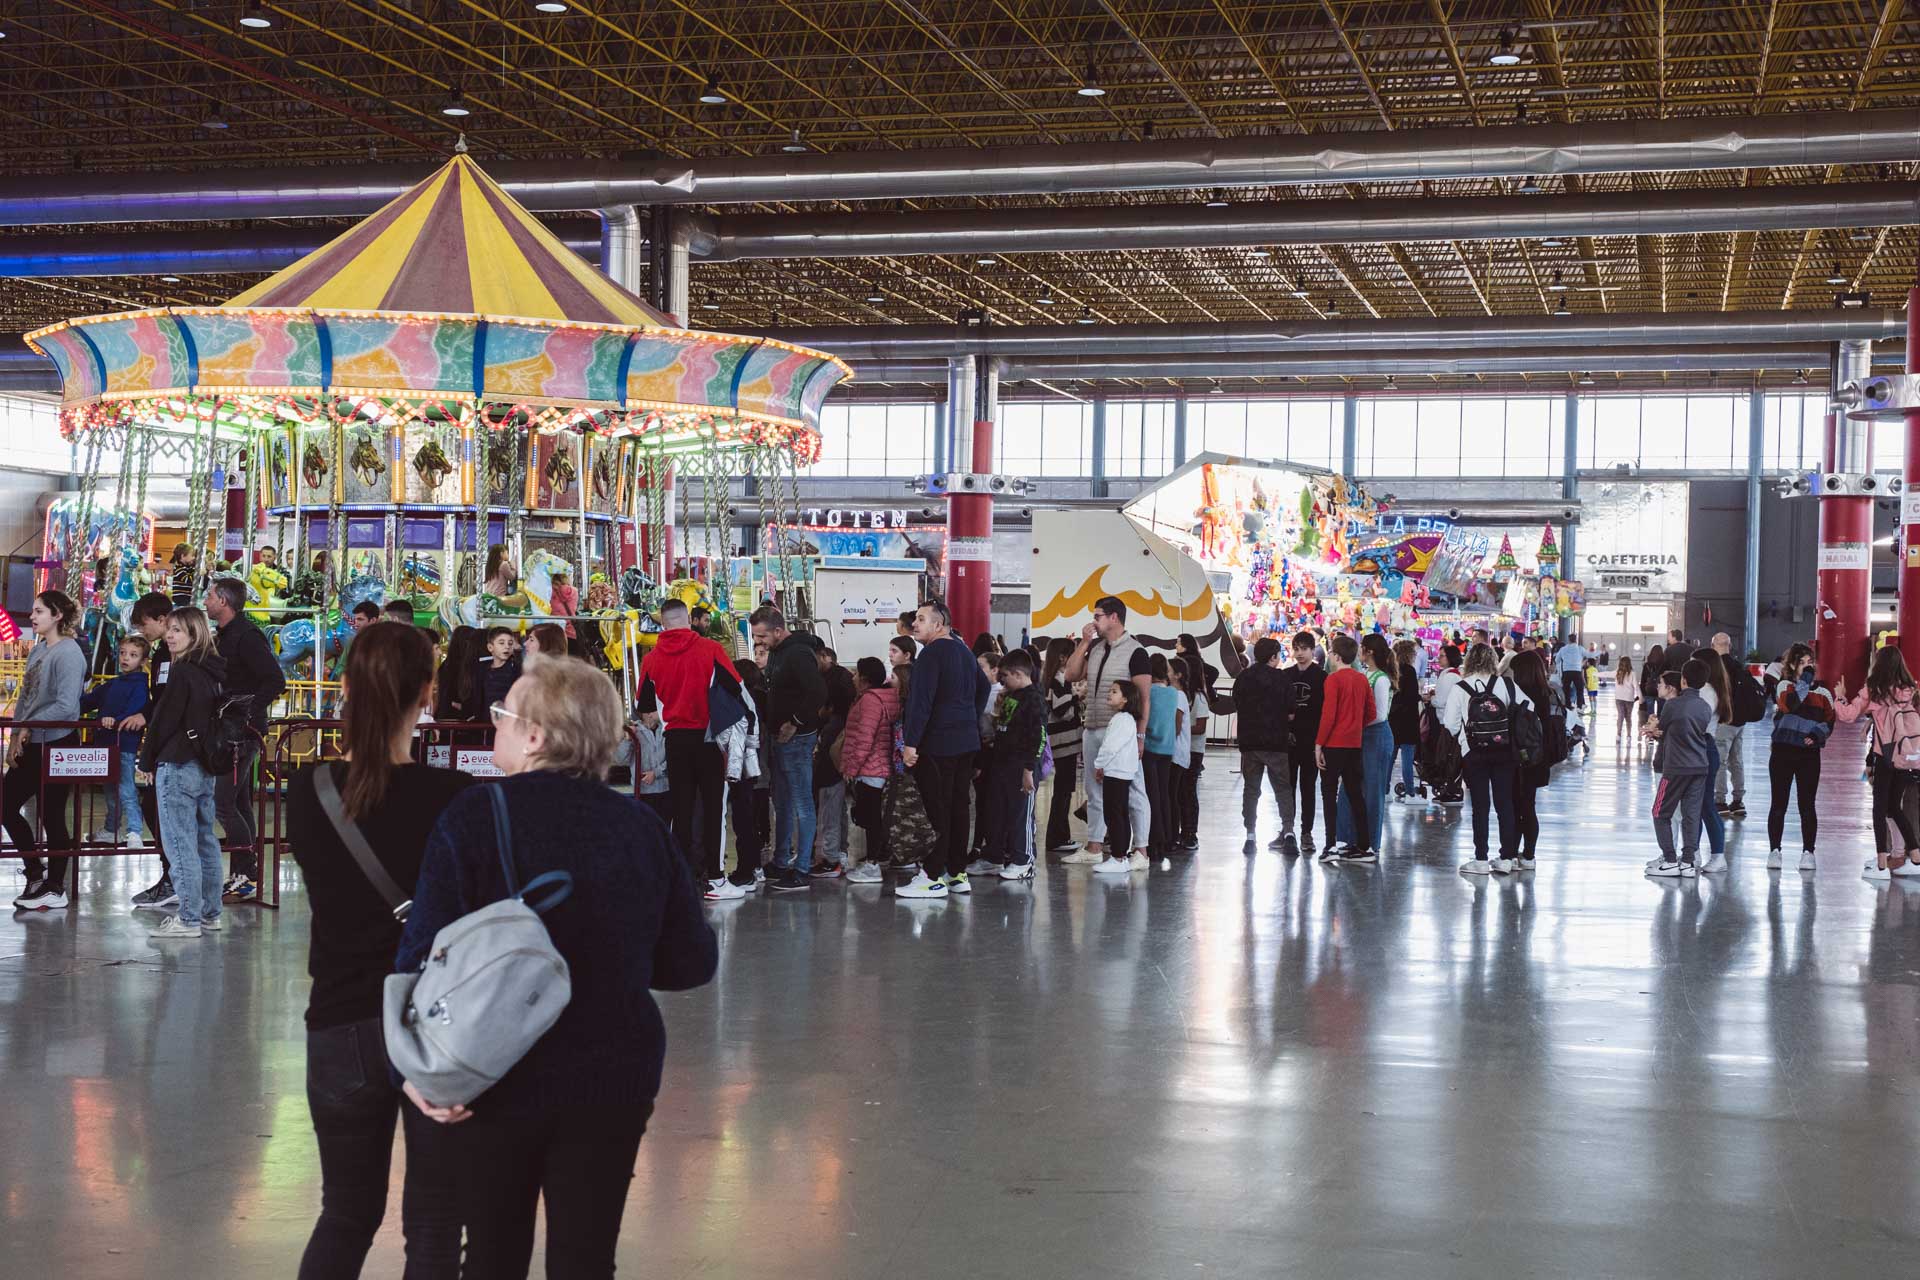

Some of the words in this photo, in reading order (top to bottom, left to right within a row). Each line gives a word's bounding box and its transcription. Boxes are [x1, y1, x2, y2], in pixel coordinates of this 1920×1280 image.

[807, 508, 907, 528] TOTEM
[1378, 515, 1405, 534] LA
[1587, 554, 1678, 565] CAFETERIA
[67, 750, 107, 761] evealia
[472, 755, 494, 763] evea
